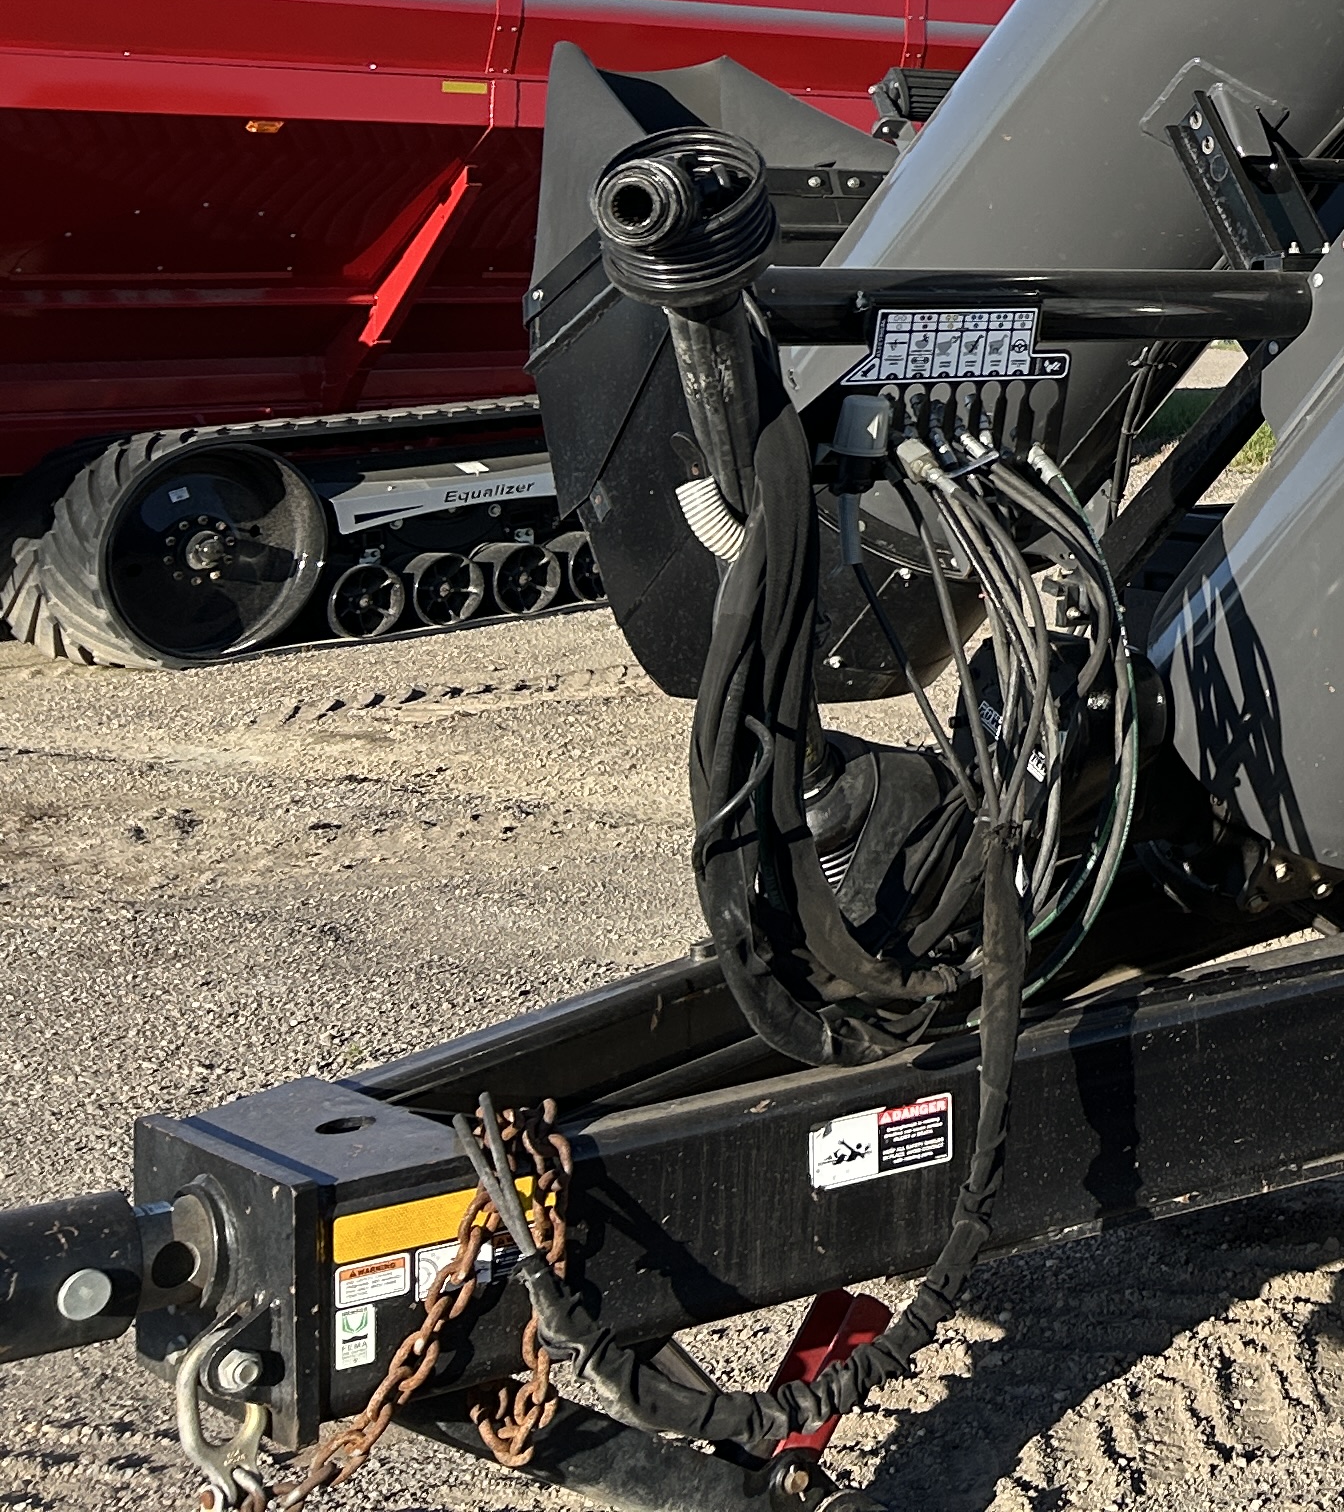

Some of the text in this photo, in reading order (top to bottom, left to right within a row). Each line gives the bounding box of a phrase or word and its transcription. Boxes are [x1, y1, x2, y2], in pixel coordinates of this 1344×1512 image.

[444, 482, 535, 503] Equalizer
[892, 1100, 946, 1120] DANGER
[358, 1263, 396, 1275] WARNING
[342, 1341, 368, 1352] FEMA
